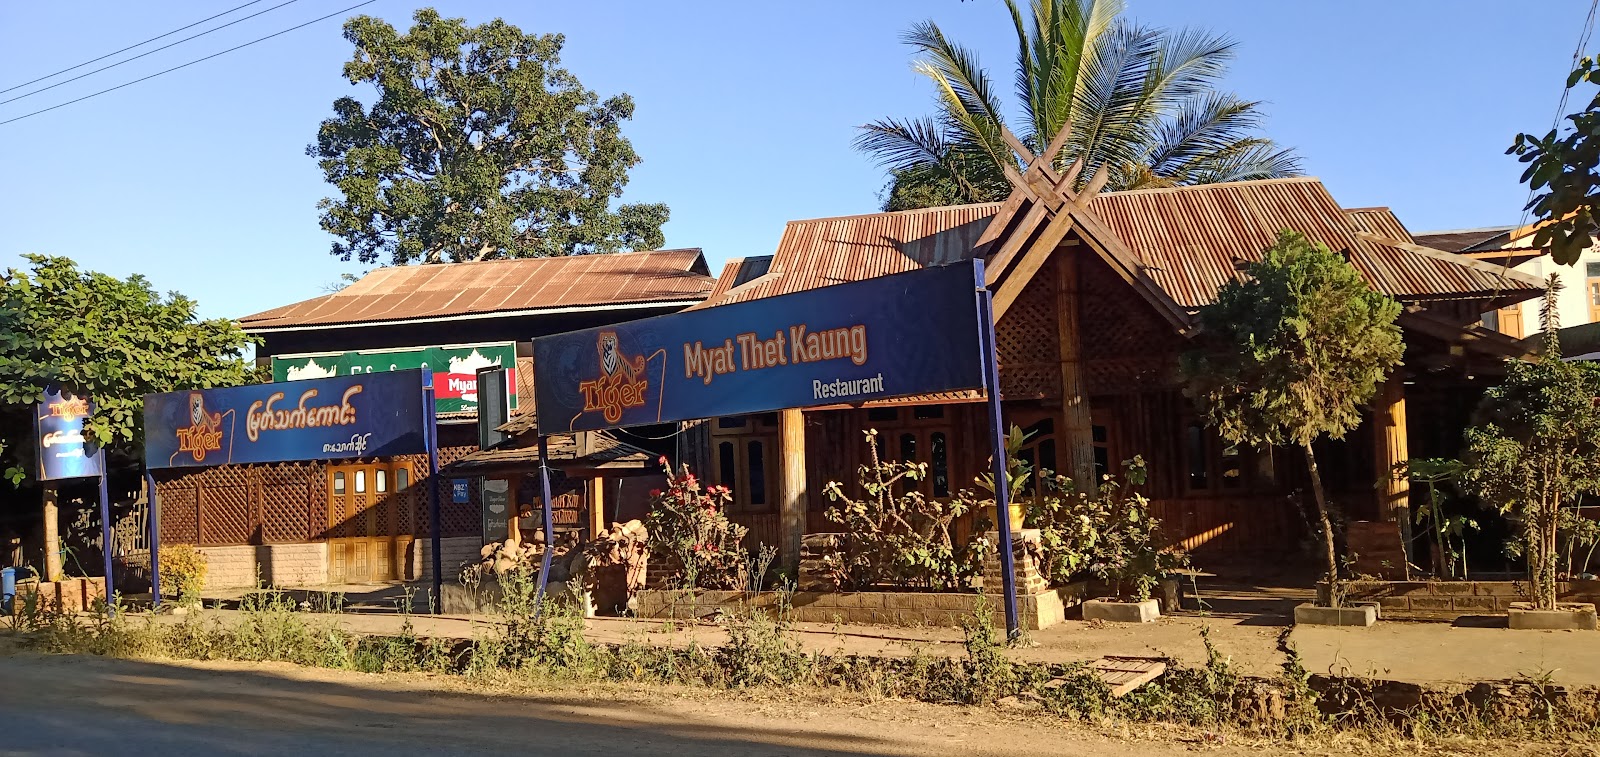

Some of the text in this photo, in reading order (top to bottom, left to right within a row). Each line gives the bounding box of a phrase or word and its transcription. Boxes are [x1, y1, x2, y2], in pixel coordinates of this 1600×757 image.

[684, 324, 868, 385] Myat Thet Kaung
[579, 374, 648, 424] Tiger
[813, 373, 884, 400] Restaurant
[49, 396, 89, 422] Tiger
[247, 385, 363, 442] မြတ်သက်ကောင်း
[176, 425, 223, 461] Tiger
